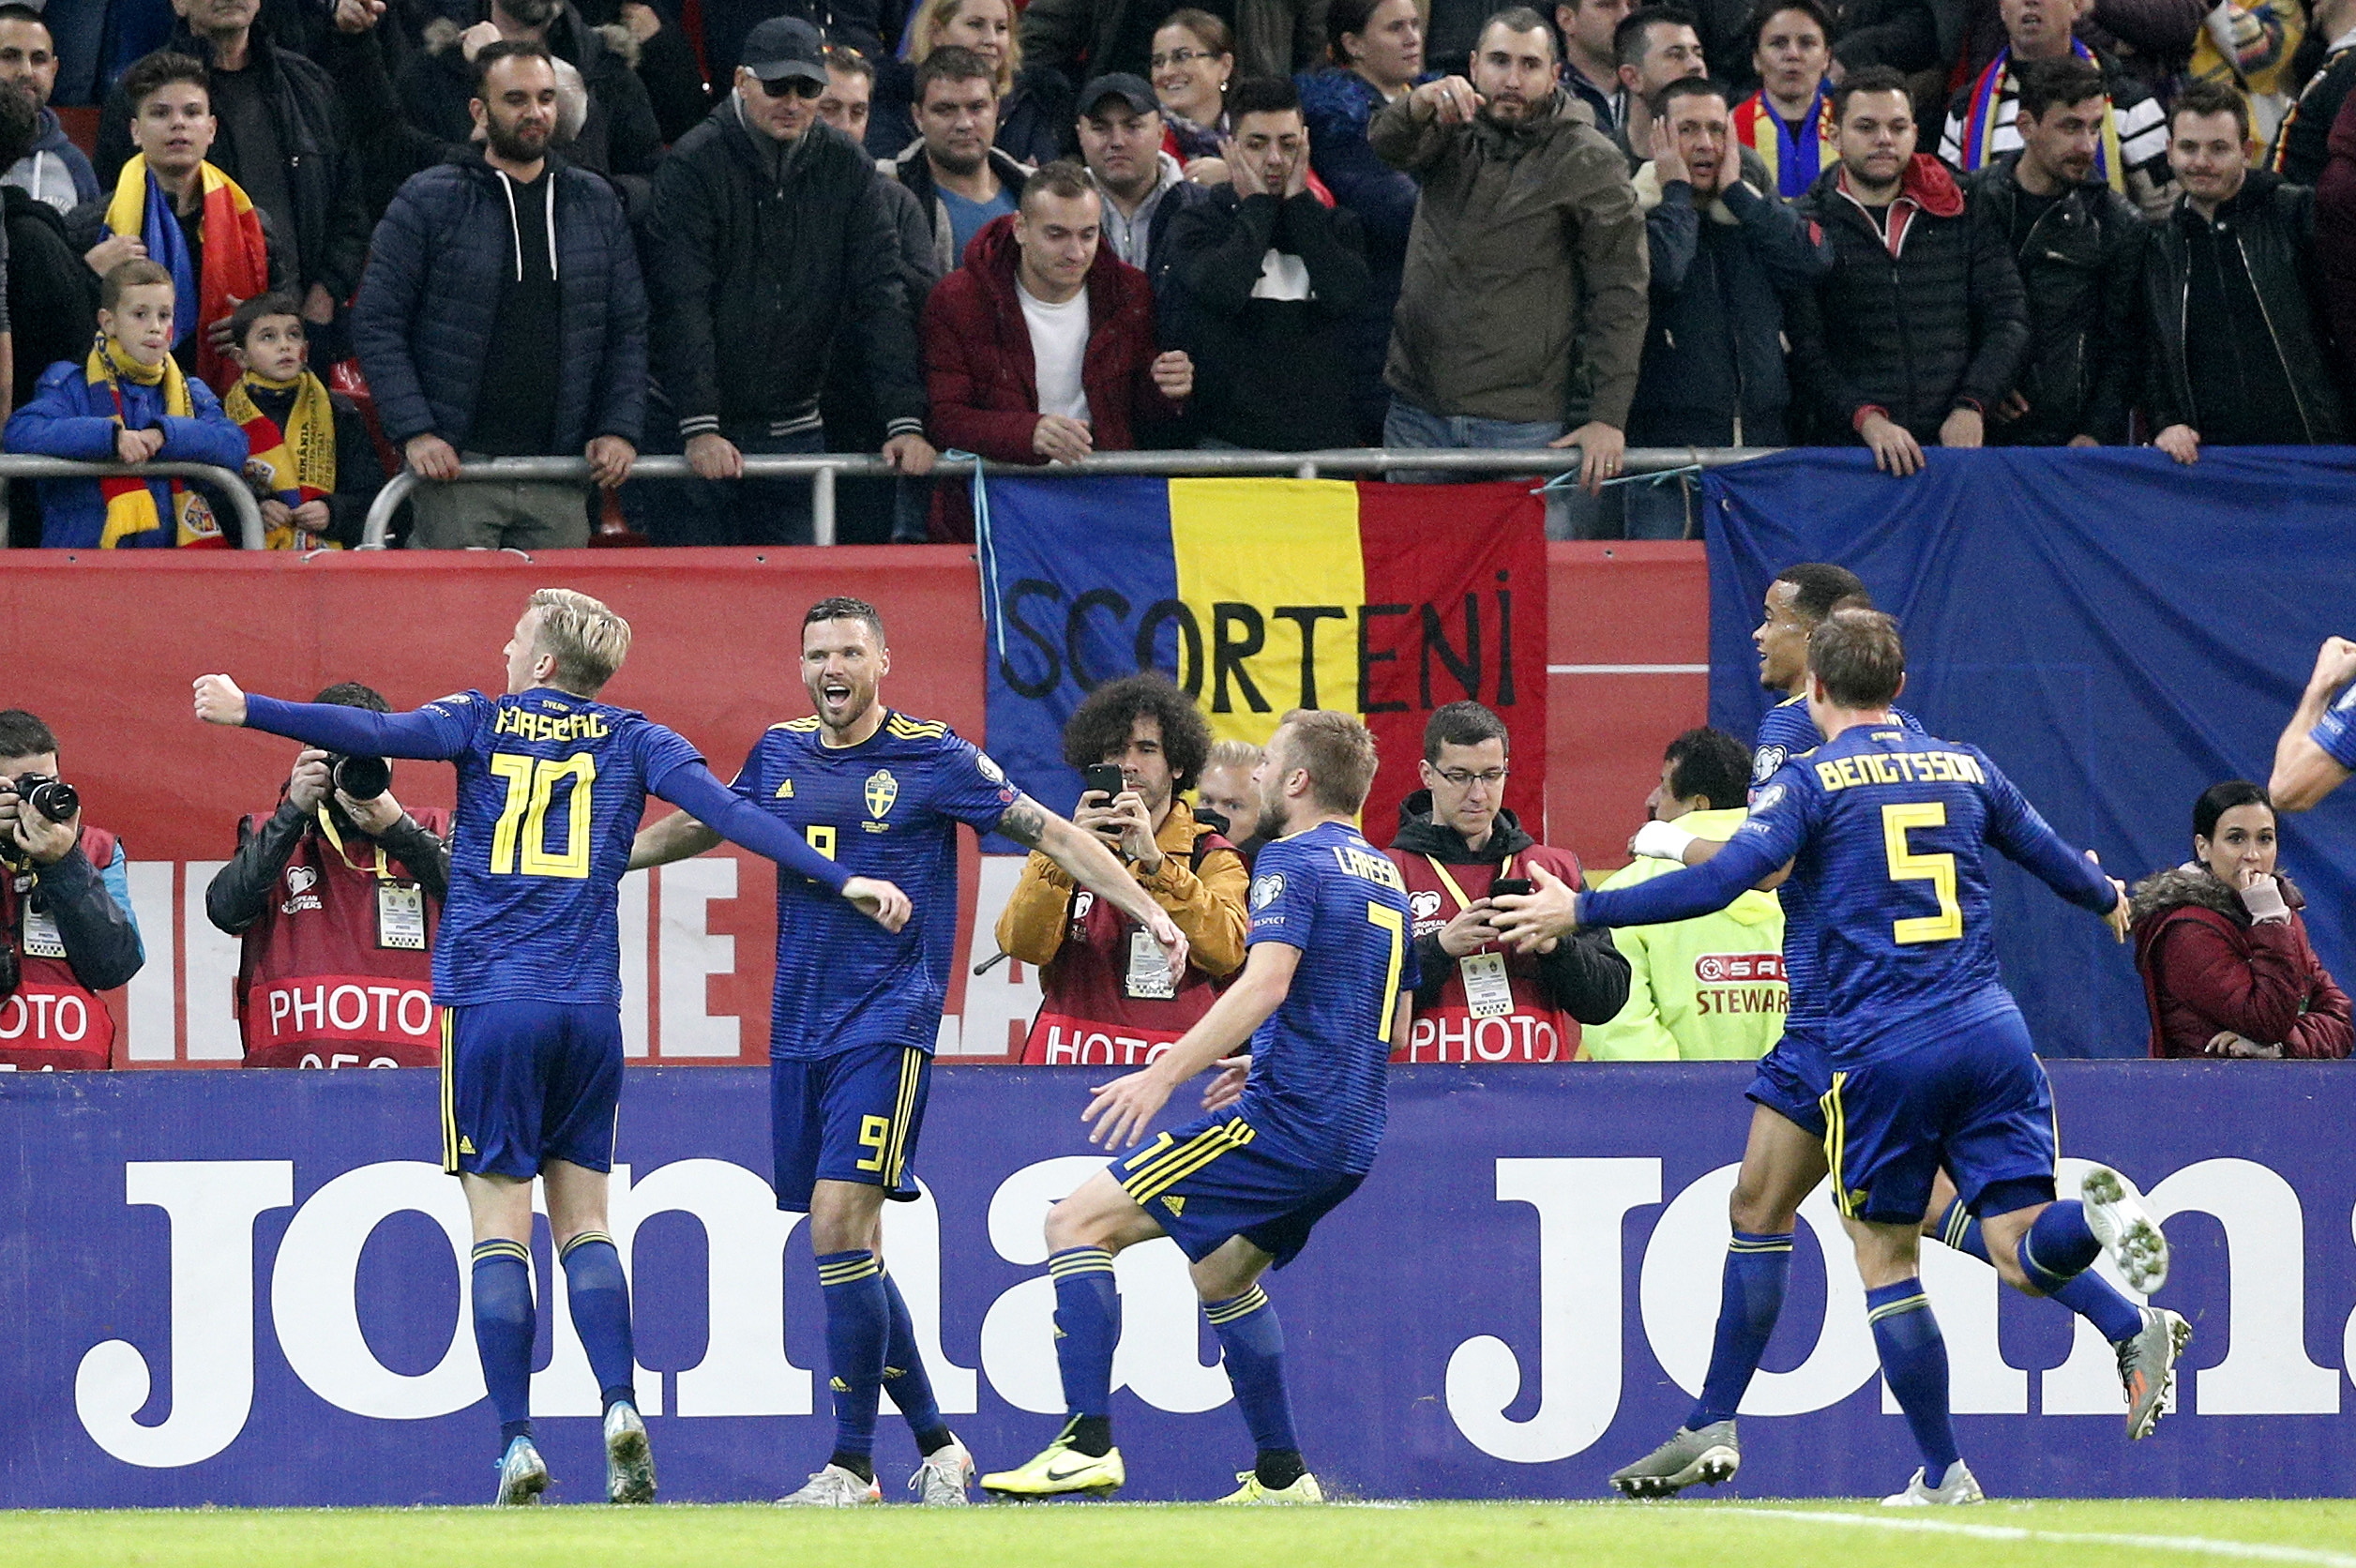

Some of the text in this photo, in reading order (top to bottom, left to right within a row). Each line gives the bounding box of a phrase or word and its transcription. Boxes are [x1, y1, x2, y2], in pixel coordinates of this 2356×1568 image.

[1815, 751, 1986, 792] BENGTSSON
[491, 752, 597, 879] 10
[1333, 846, 1408, 895] LARSSO
[1881, 802, 1963, 944] 5
[1367, 899, 1405, 1045] 7
[0, 994, 87, 1042] OTO
[269, 984, 433, 1036] PHOTO
[1696, 988, 1790, 1016] STEWAR
[1410, 1015, 1559, 1063] PHOTO
[856, 1114, 890, 1173] 9
[1444, 1156, 2356, 1463] Jom
